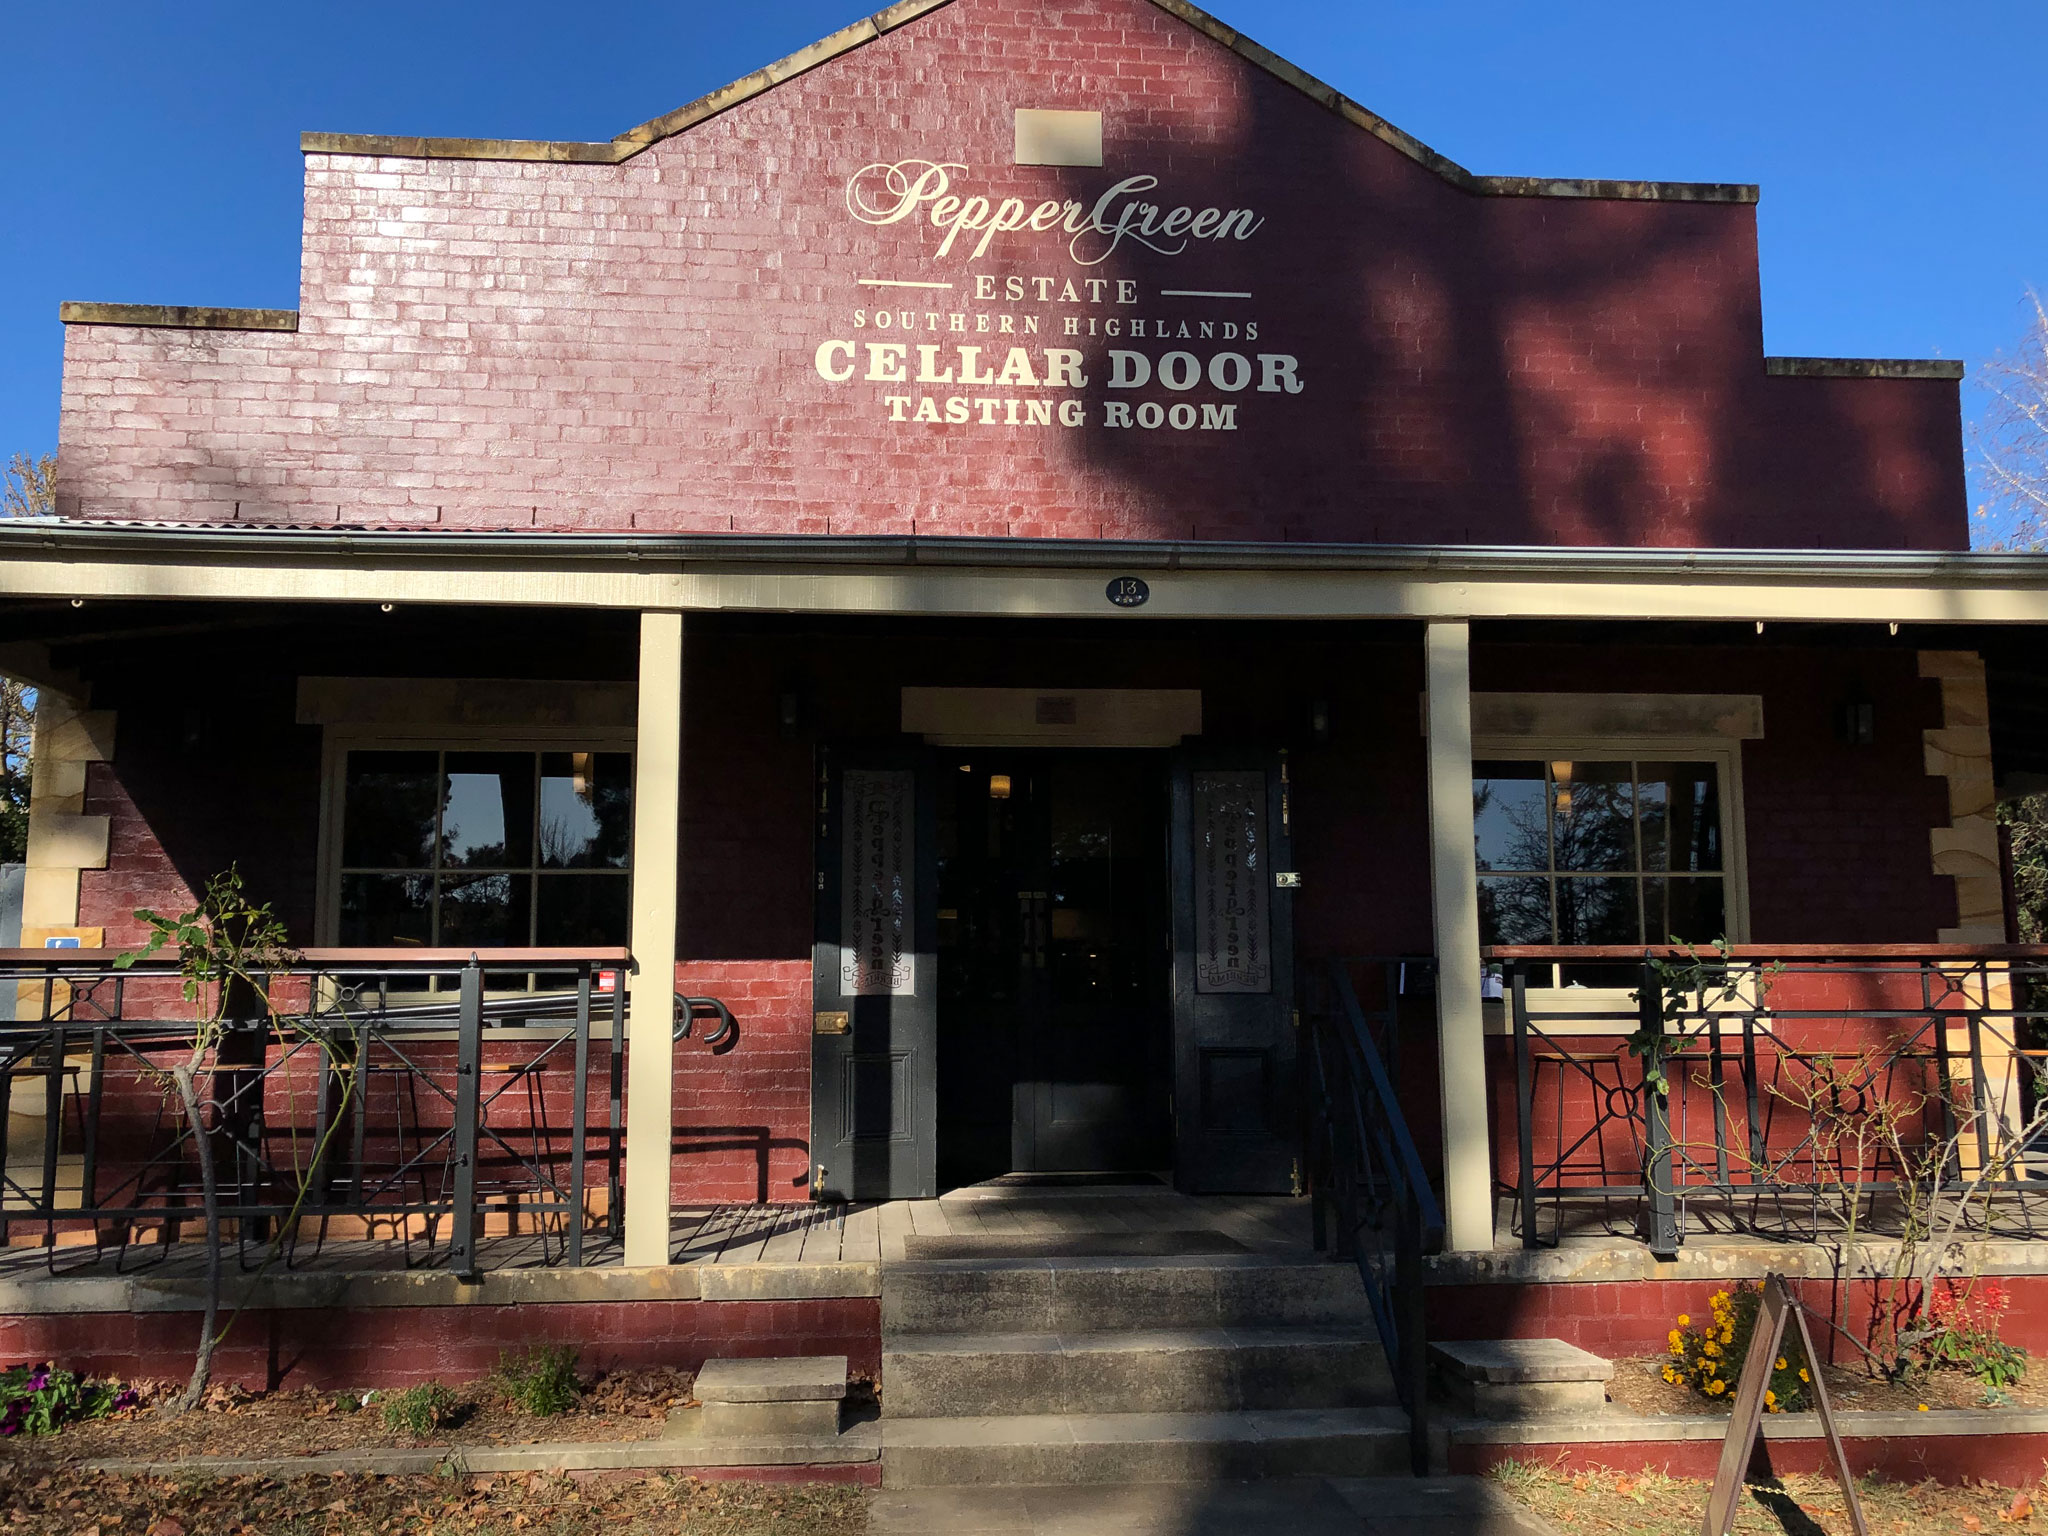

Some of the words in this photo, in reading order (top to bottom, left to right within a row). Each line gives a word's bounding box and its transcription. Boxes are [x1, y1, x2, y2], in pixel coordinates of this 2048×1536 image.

[846, 159, 1265, 265] PepperGreen
[975, 275, 1138, 305] ESTATE
[854, 309, 1040, 334] SOUTHERN
[1064, 317, 1259, 341] HIGHLANDS
[815, 340, 1089, 388] CELLAR
[1108, 350, 1304, 394] DOOR
[884, 396, 1086, 428] TASTING
[1104, 401, 1238, 431] ROOM
[1120, 580, 1137, 594] 13
